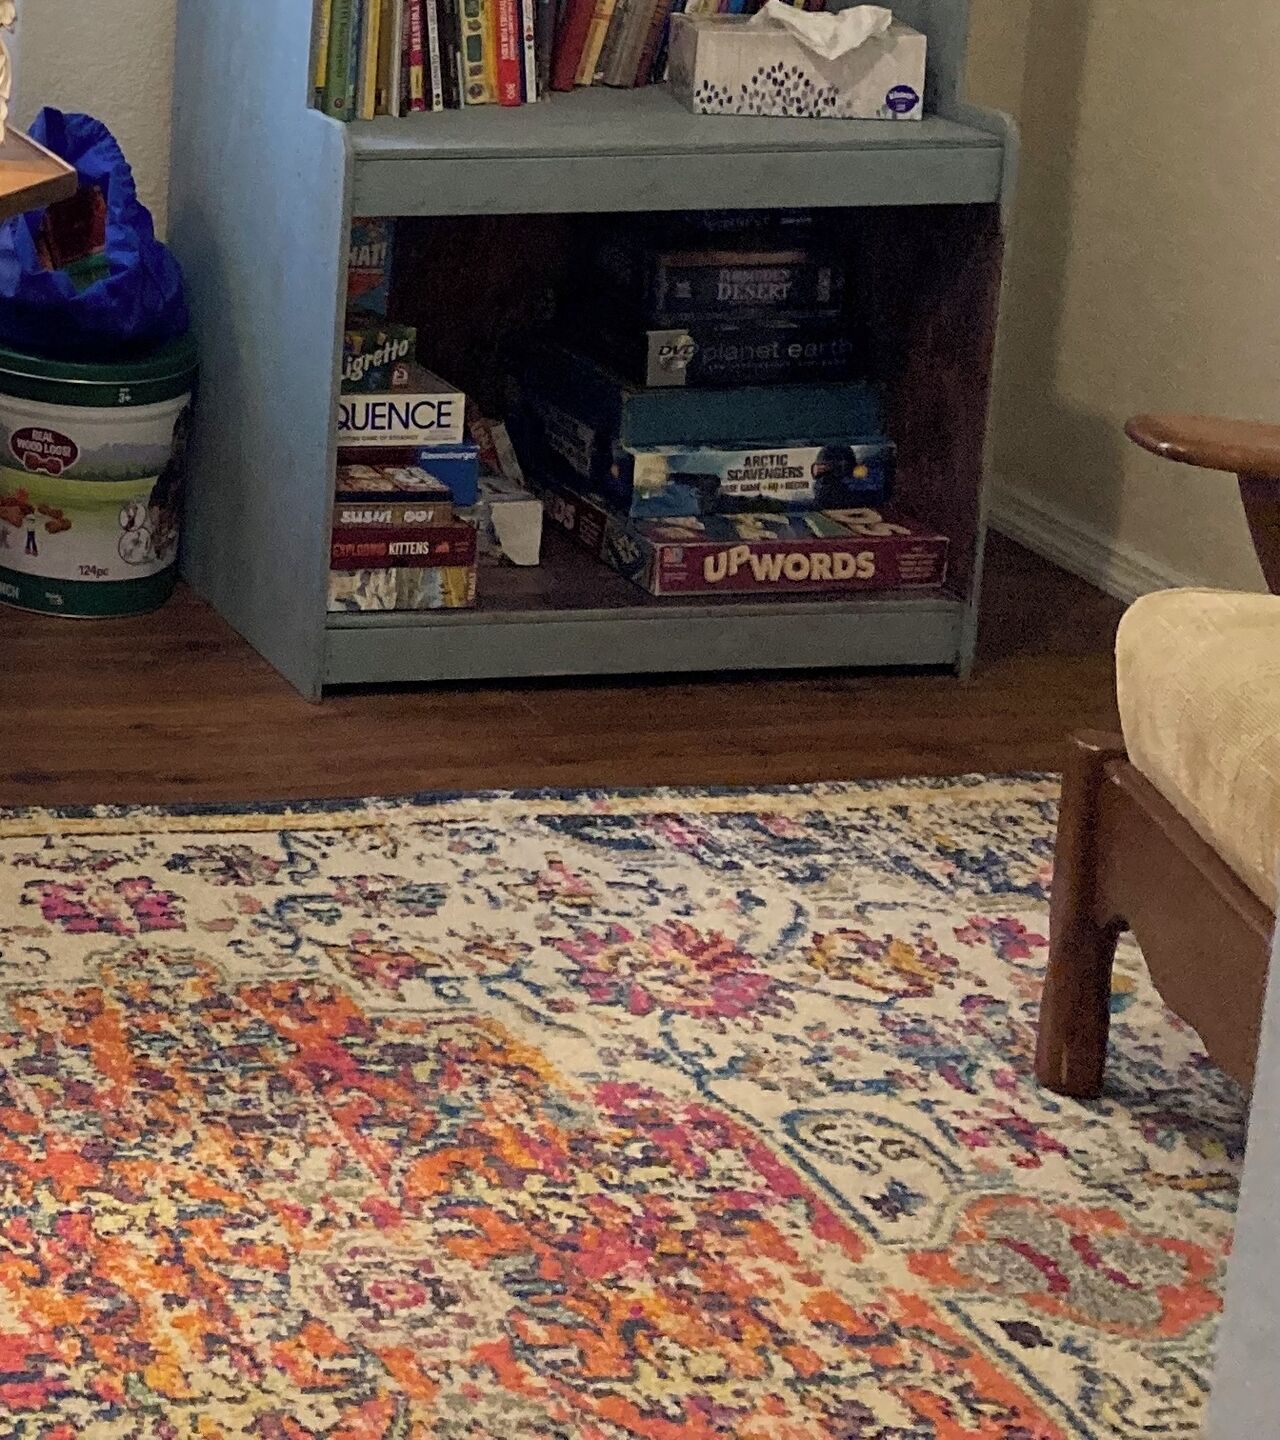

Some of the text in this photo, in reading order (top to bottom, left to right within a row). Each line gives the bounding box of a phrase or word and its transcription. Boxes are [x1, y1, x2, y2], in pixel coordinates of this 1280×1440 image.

[410, 5, 422, 51] TWISTER
[341, 338, 410, 382] igretto
[744, 454, 788, 467] ARCTIC
[727, 466, 804, 481] SCAVENGERS
[340, 509, 393, 524] SUSHI
[388, 541, 430, 556] KITTENS
[703, 544, 876, 584] UPWORDS
